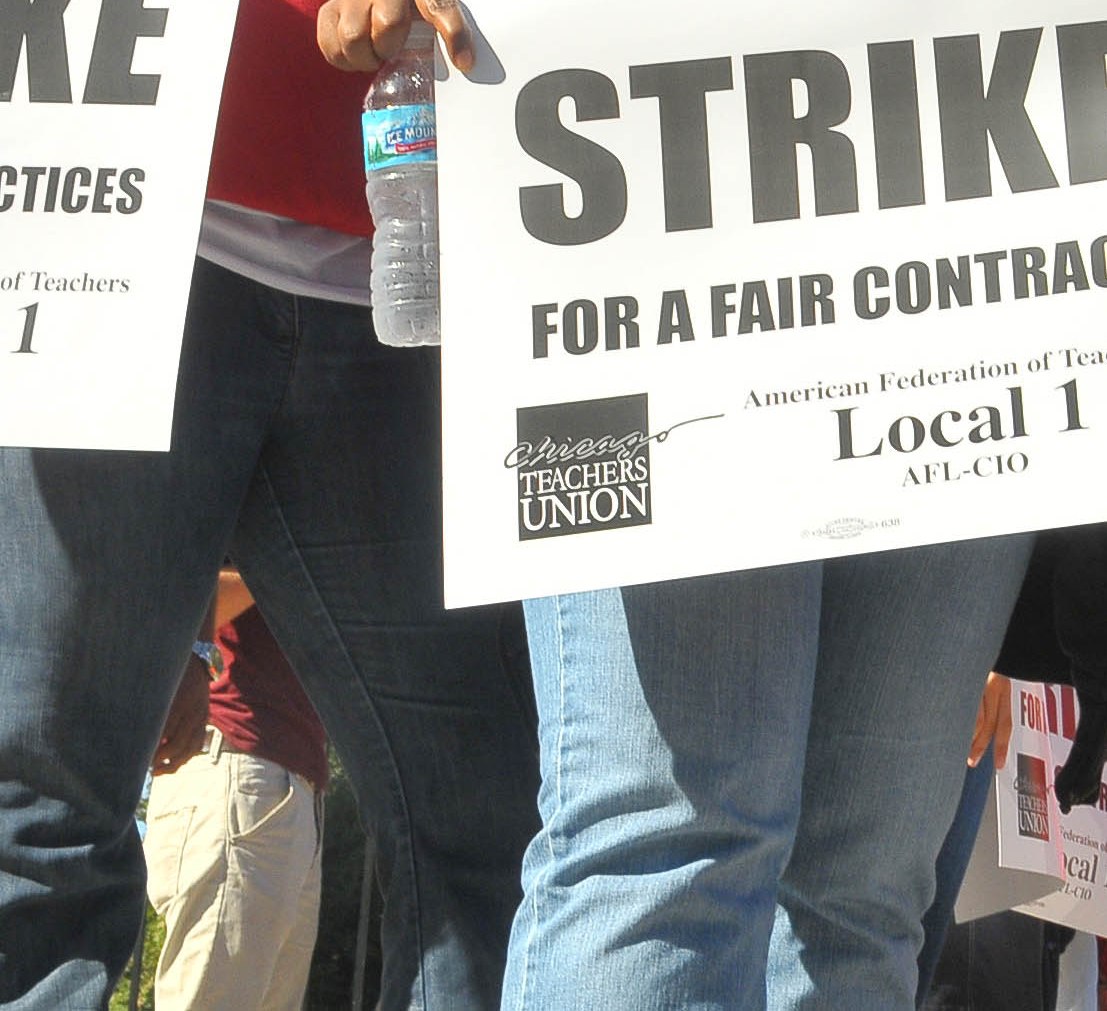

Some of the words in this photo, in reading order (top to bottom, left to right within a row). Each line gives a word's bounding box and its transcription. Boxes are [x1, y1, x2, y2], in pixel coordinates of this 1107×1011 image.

[1, 272, 26, 291] of
[30, 271, 131, 294] Teachers
[10, 301, 40, 355] 1
[532, 295, 640, 360] FOR
[657, 289, 696, 346] A
[710, 273, 836, 339] FAIR
[744, 380, 869, 410] American
[879, 360, 1019, 393] Federation
[1027, 351, 1053, 374] of
[830, 386, 1030, 462] Local
[1054, 377, 1091, 433] 1
[504, 421, 690, 469] Chicago
[520, 455, 648, 497] TEACHERS
[902, 451, 1029, 488] AFL-CIO
[519, 482, 649, 532] UNION
[1020, 690, 1042, 732] FOR
[1059, 882, 1092, 901] L-CIO
